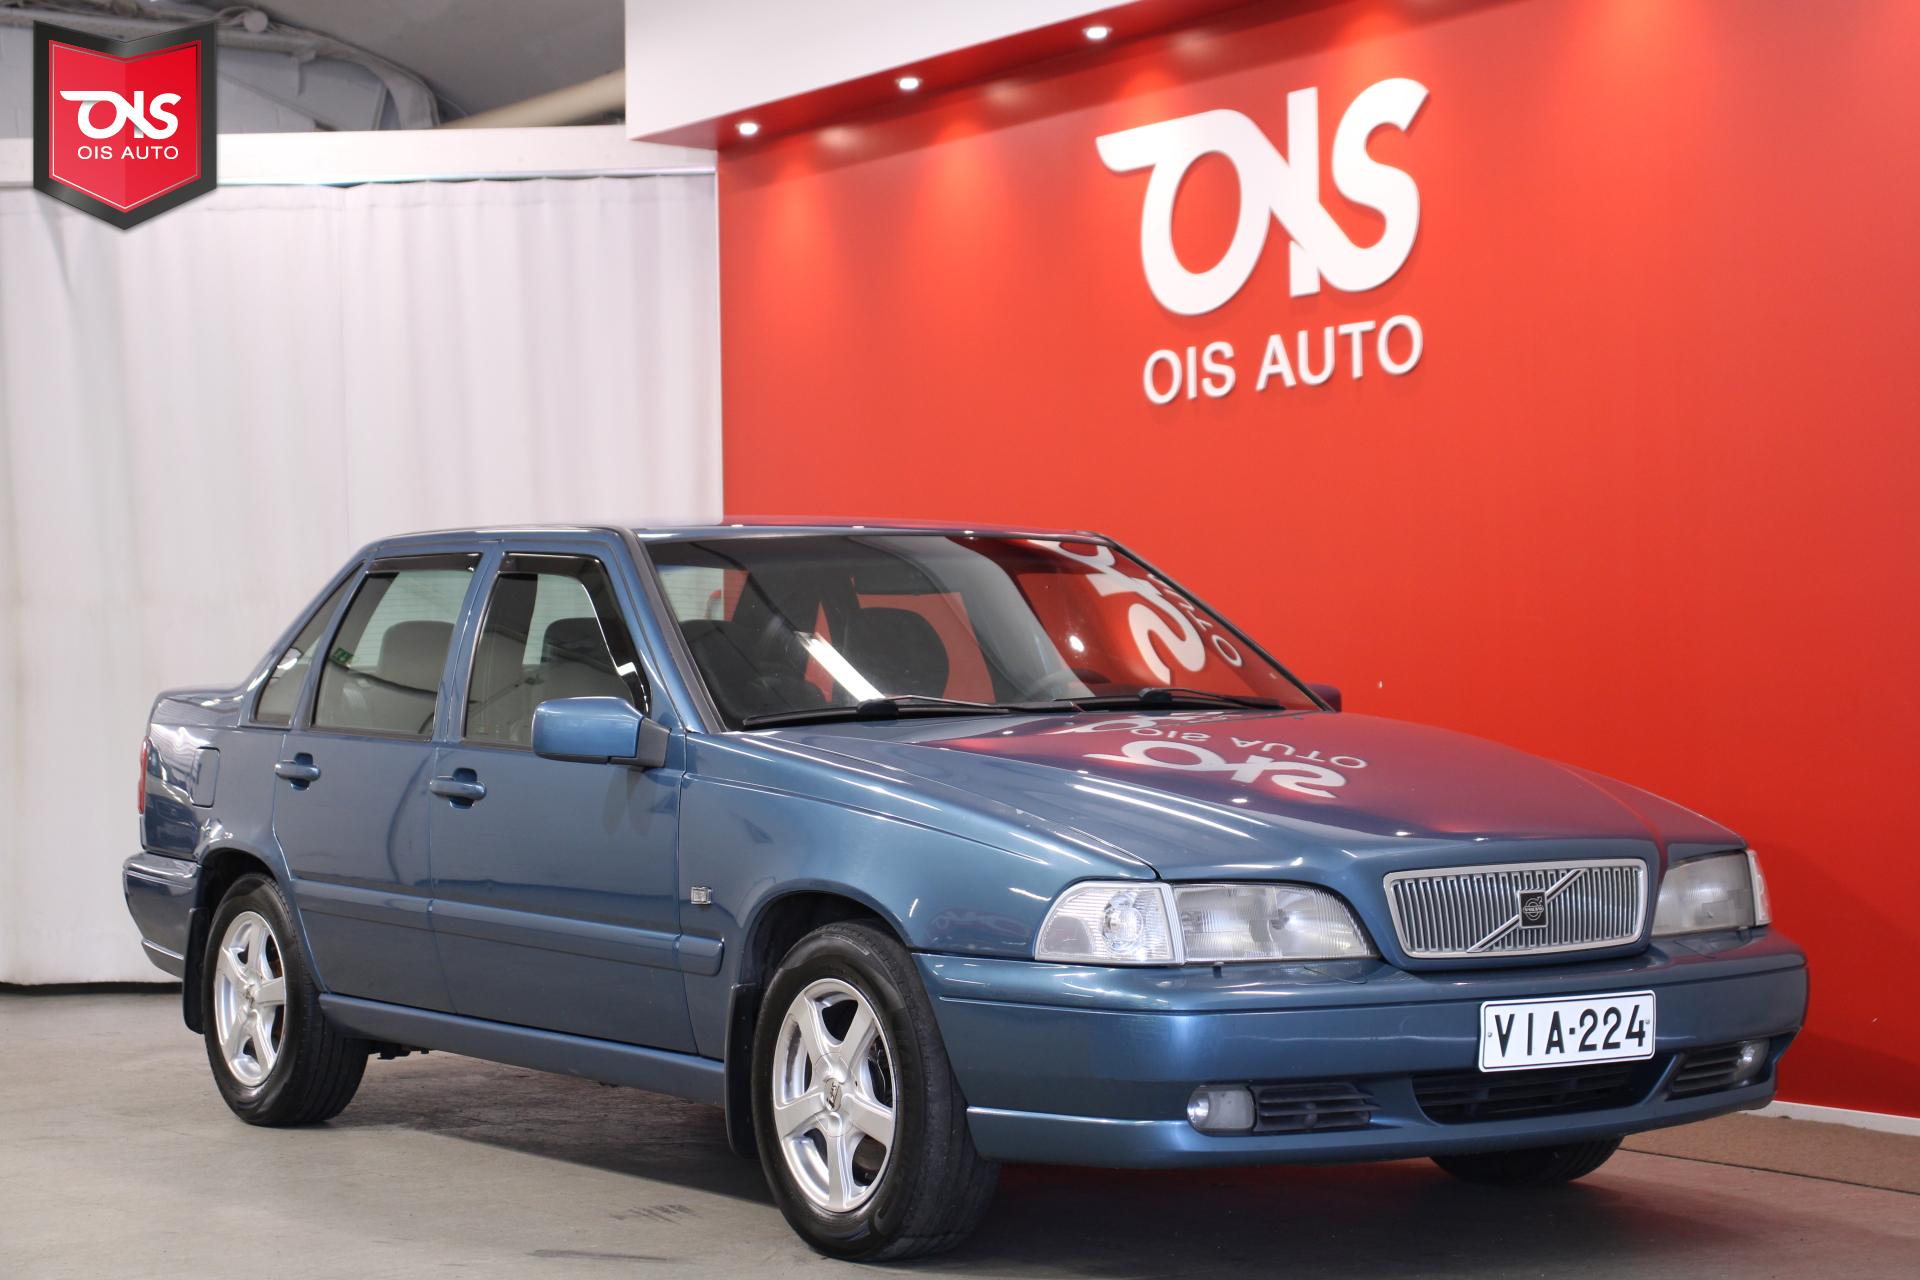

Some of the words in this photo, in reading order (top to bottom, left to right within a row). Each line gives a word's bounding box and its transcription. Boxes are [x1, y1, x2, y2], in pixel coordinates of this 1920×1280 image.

[1095, 77, 1430, 316] OIS
[1143, 341, 1237, 405] OIS
[1255, 314, 1424, 391] AUTO
